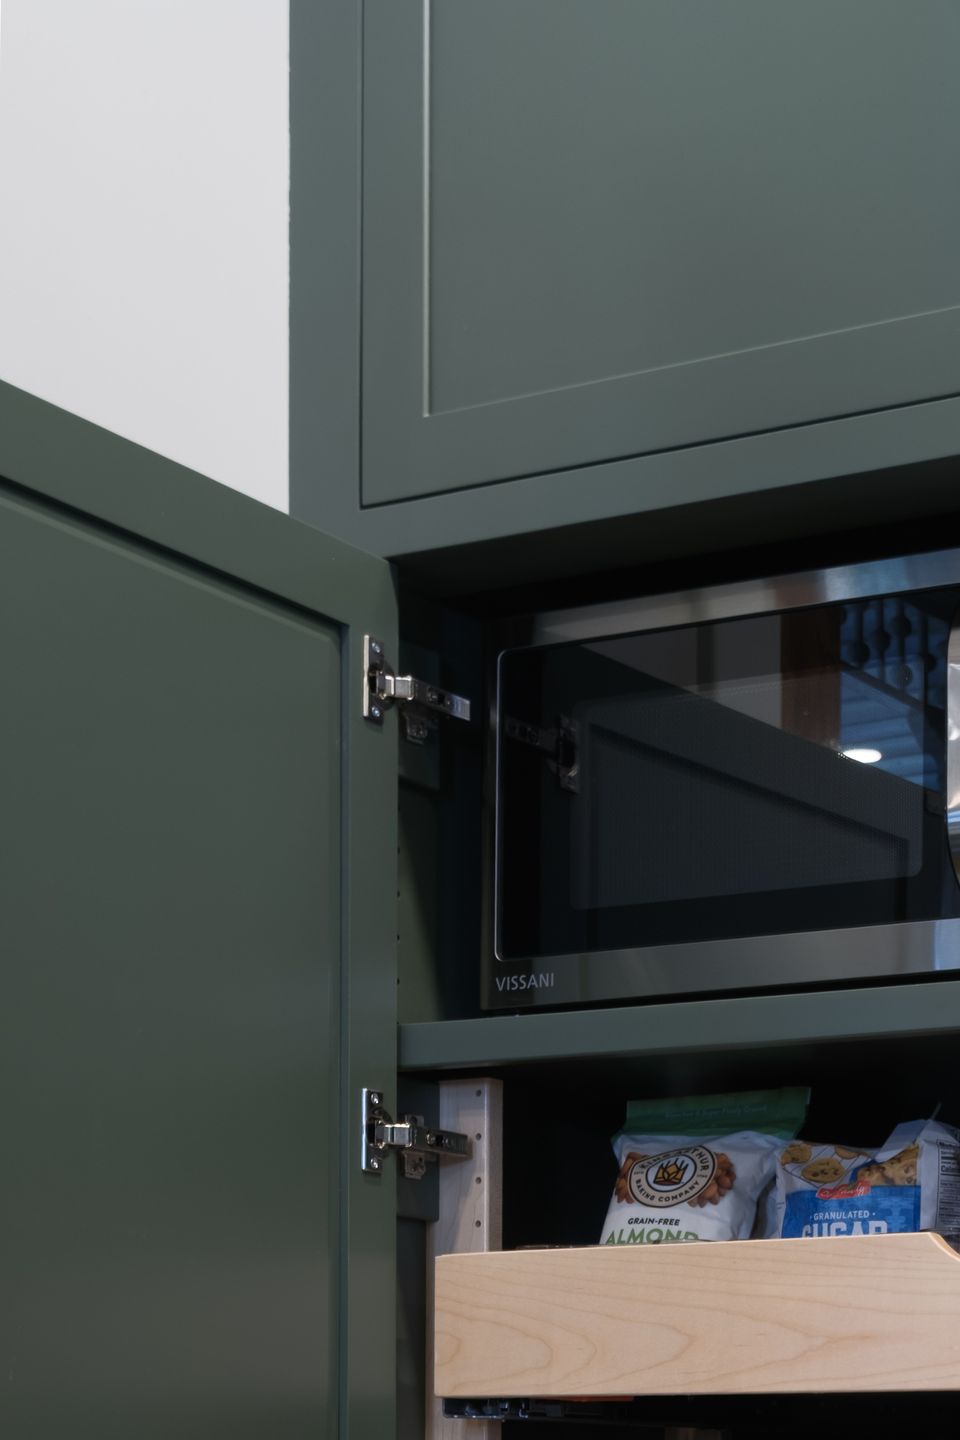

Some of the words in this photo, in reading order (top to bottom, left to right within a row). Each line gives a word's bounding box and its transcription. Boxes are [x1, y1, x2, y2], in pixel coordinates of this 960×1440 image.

[495, 973, 555, 992] VISSANI
[657, 1180, 701, 1202] COMPANY
[627, 1217, 681, 1227] GRAIN-FREE
[813, 1210, 870, 1222] GRANULATED
